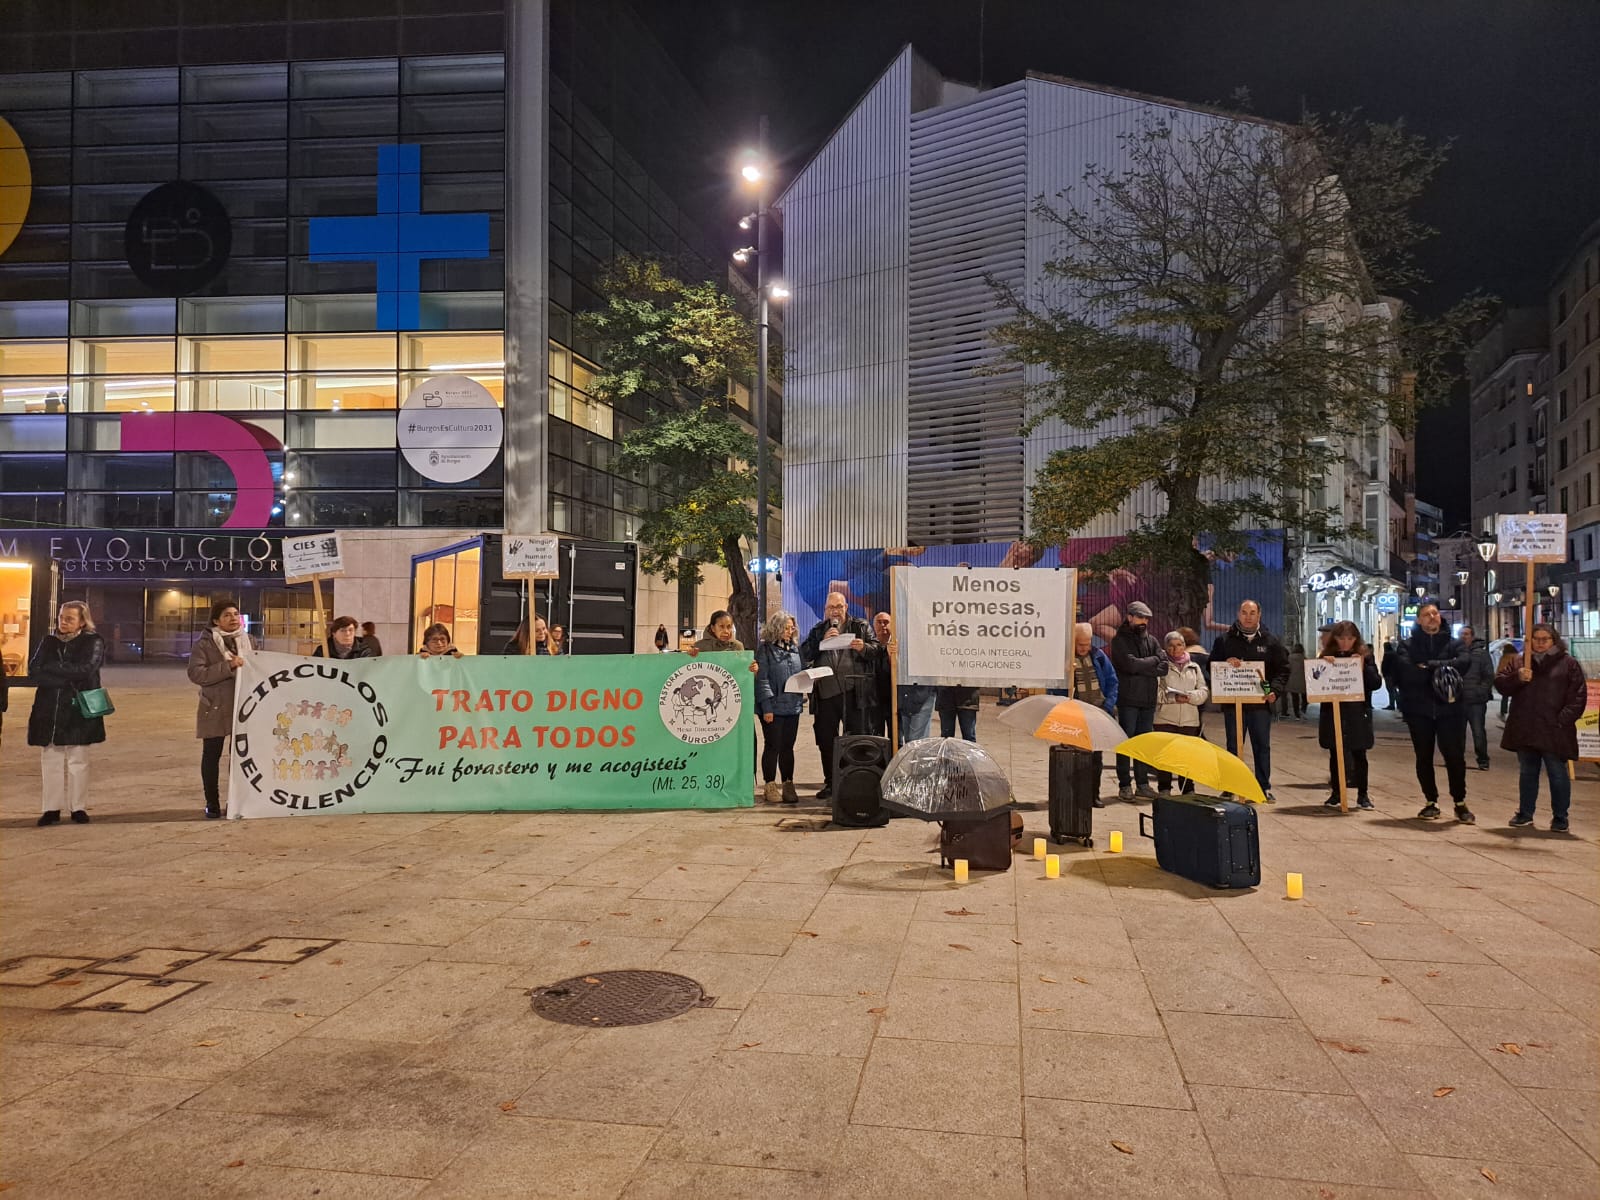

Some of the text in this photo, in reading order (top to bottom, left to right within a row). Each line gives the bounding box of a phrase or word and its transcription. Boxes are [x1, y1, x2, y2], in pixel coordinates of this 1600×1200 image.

[408, 424, 492, 434] #BurgosEsCultura2031
[292, 540, 316, 551] CIES
[162, 560, 169, 572] Y
[952, 575, 1021, 593] Menos
[932, 601, 1041, 618] promesas,
[927, 620, 1046, 638] más acción
[988, 649, 1032, 657] INTEGRAL
[959, 661, 1022, 669] MIGRACIONES
[660, 663, 741, 705] PASTORAL CON INMIGRANTES
[431, 688, 643, 712] TRATO DIGNO
[235, 664, 389, 809] CIRCULOS DEL SILENCIO
[438, 725, 636, 750] PARA TODOS
[681, 733, 720, 744] BURGOS
[452, 757, 539, 782] forastero
[547, 762, 557, 780] y
[565, 762, 592, 773] me
[652, 774, 725, 794] (Mt. 25, 38)
